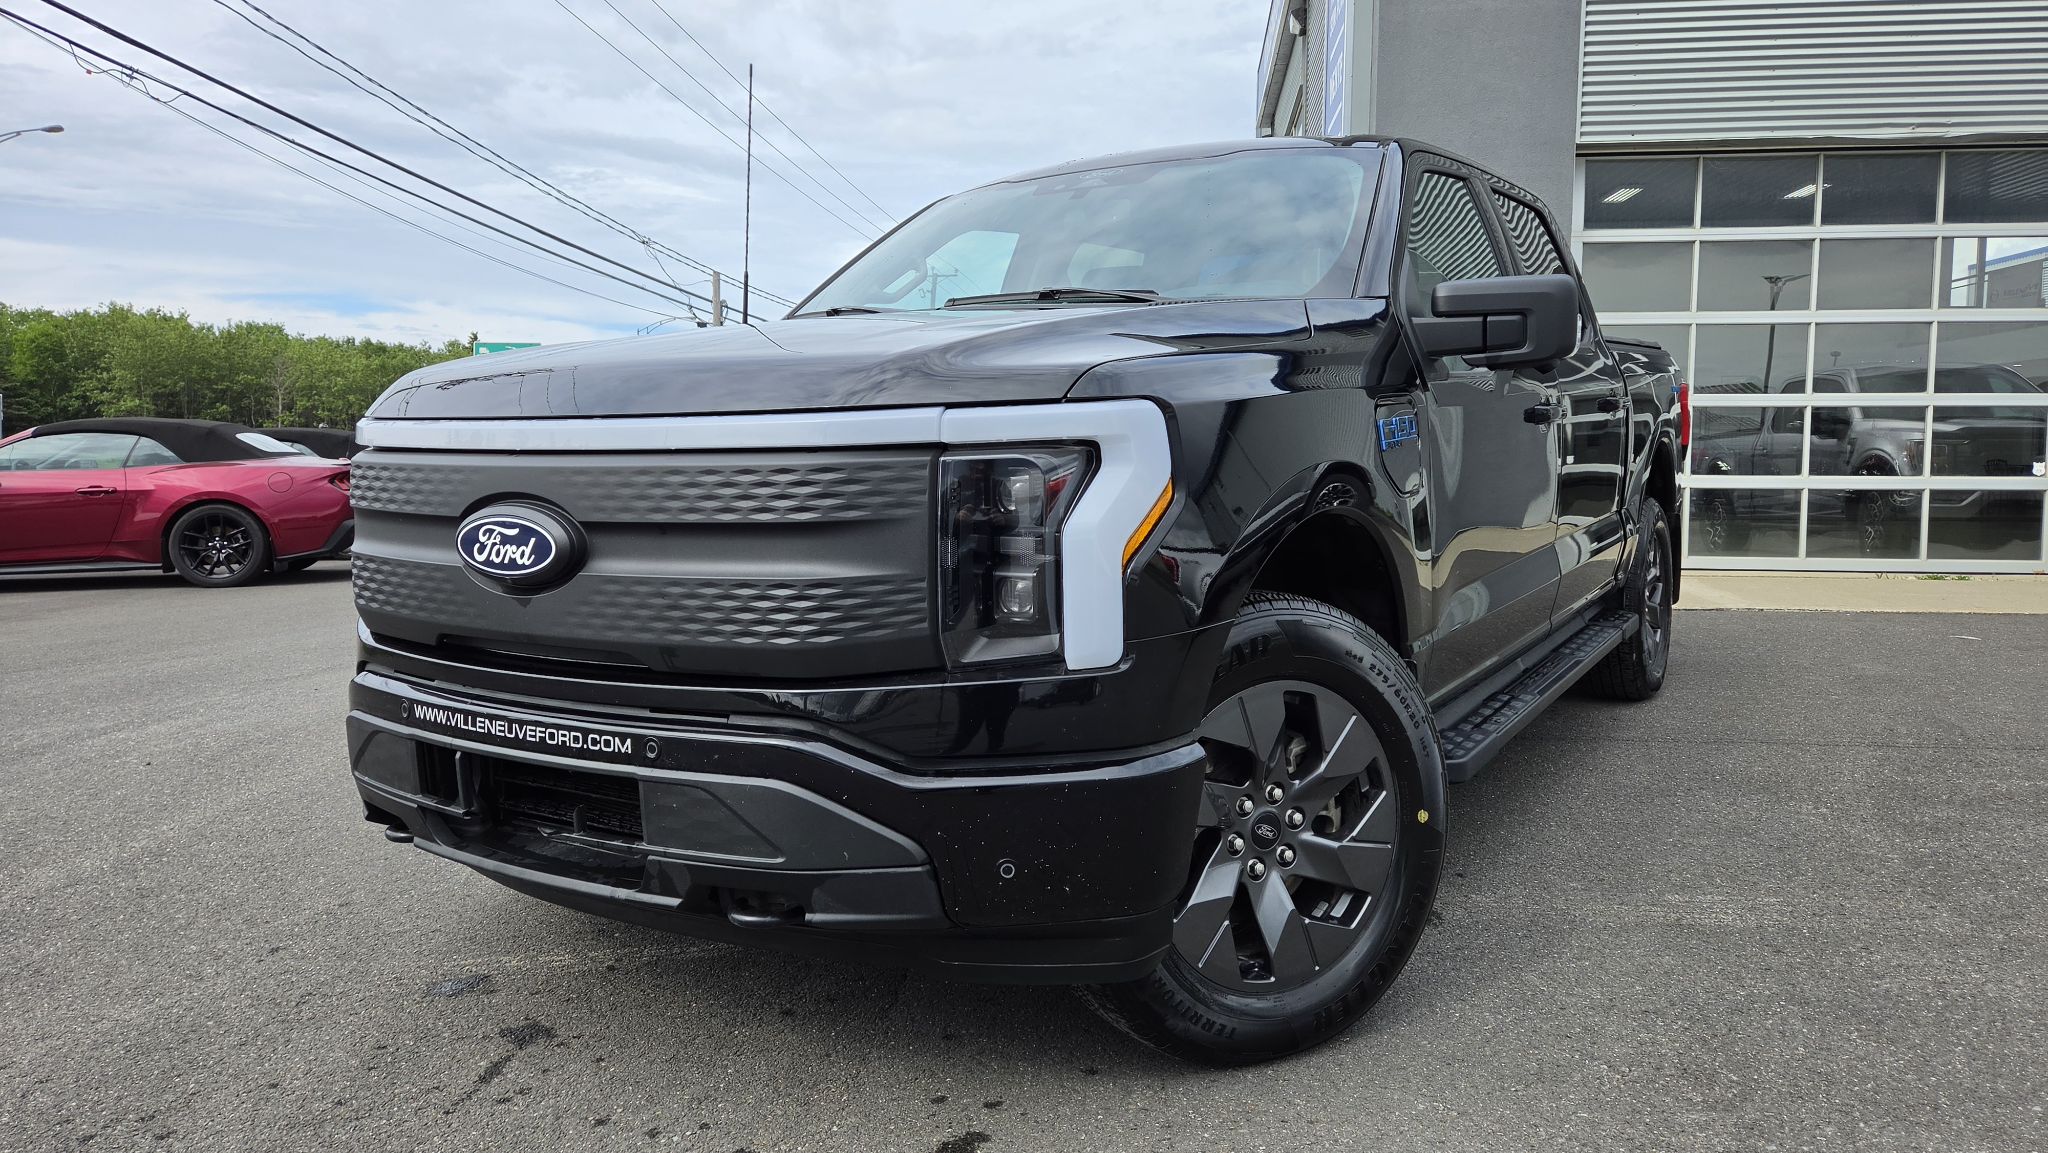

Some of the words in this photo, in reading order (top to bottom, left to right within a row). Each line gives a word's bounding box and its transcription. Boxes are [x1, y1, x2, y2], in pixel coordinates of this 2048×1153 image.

[473, 525, 536, 566] Ford
[413, 703, 632, 754] WWW.VILLENEUVEFORD.COM
[1150, 970, 1237, 1041] TERRITOR
